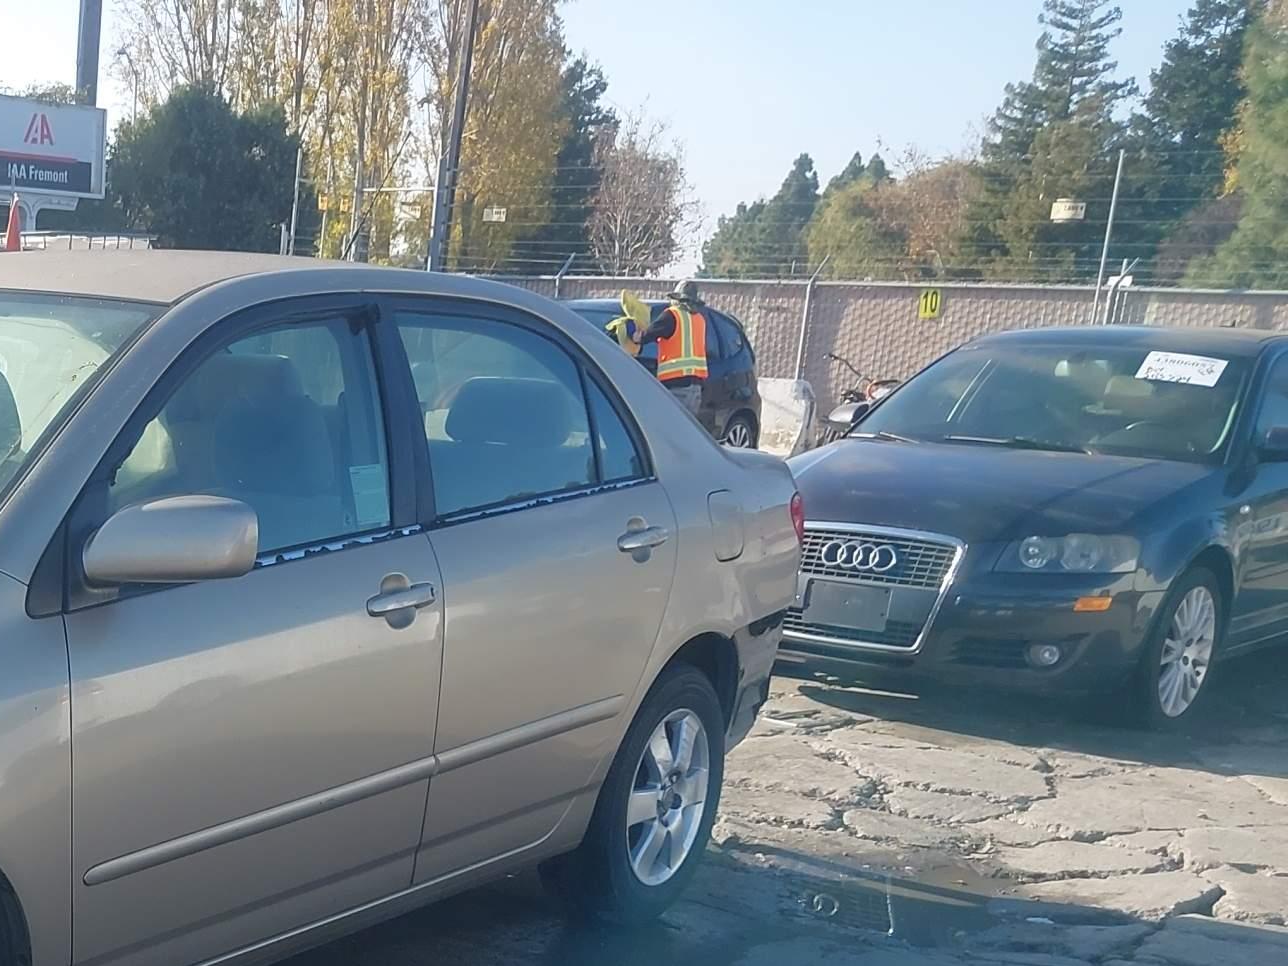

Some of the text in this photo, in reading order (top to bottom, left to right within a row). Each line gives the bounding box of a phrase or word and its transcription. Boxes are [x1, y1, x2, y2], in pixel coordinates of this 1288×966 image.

[7, 162, 68, 183] IAA Fremont
[922, 290, 939, 313] 10
